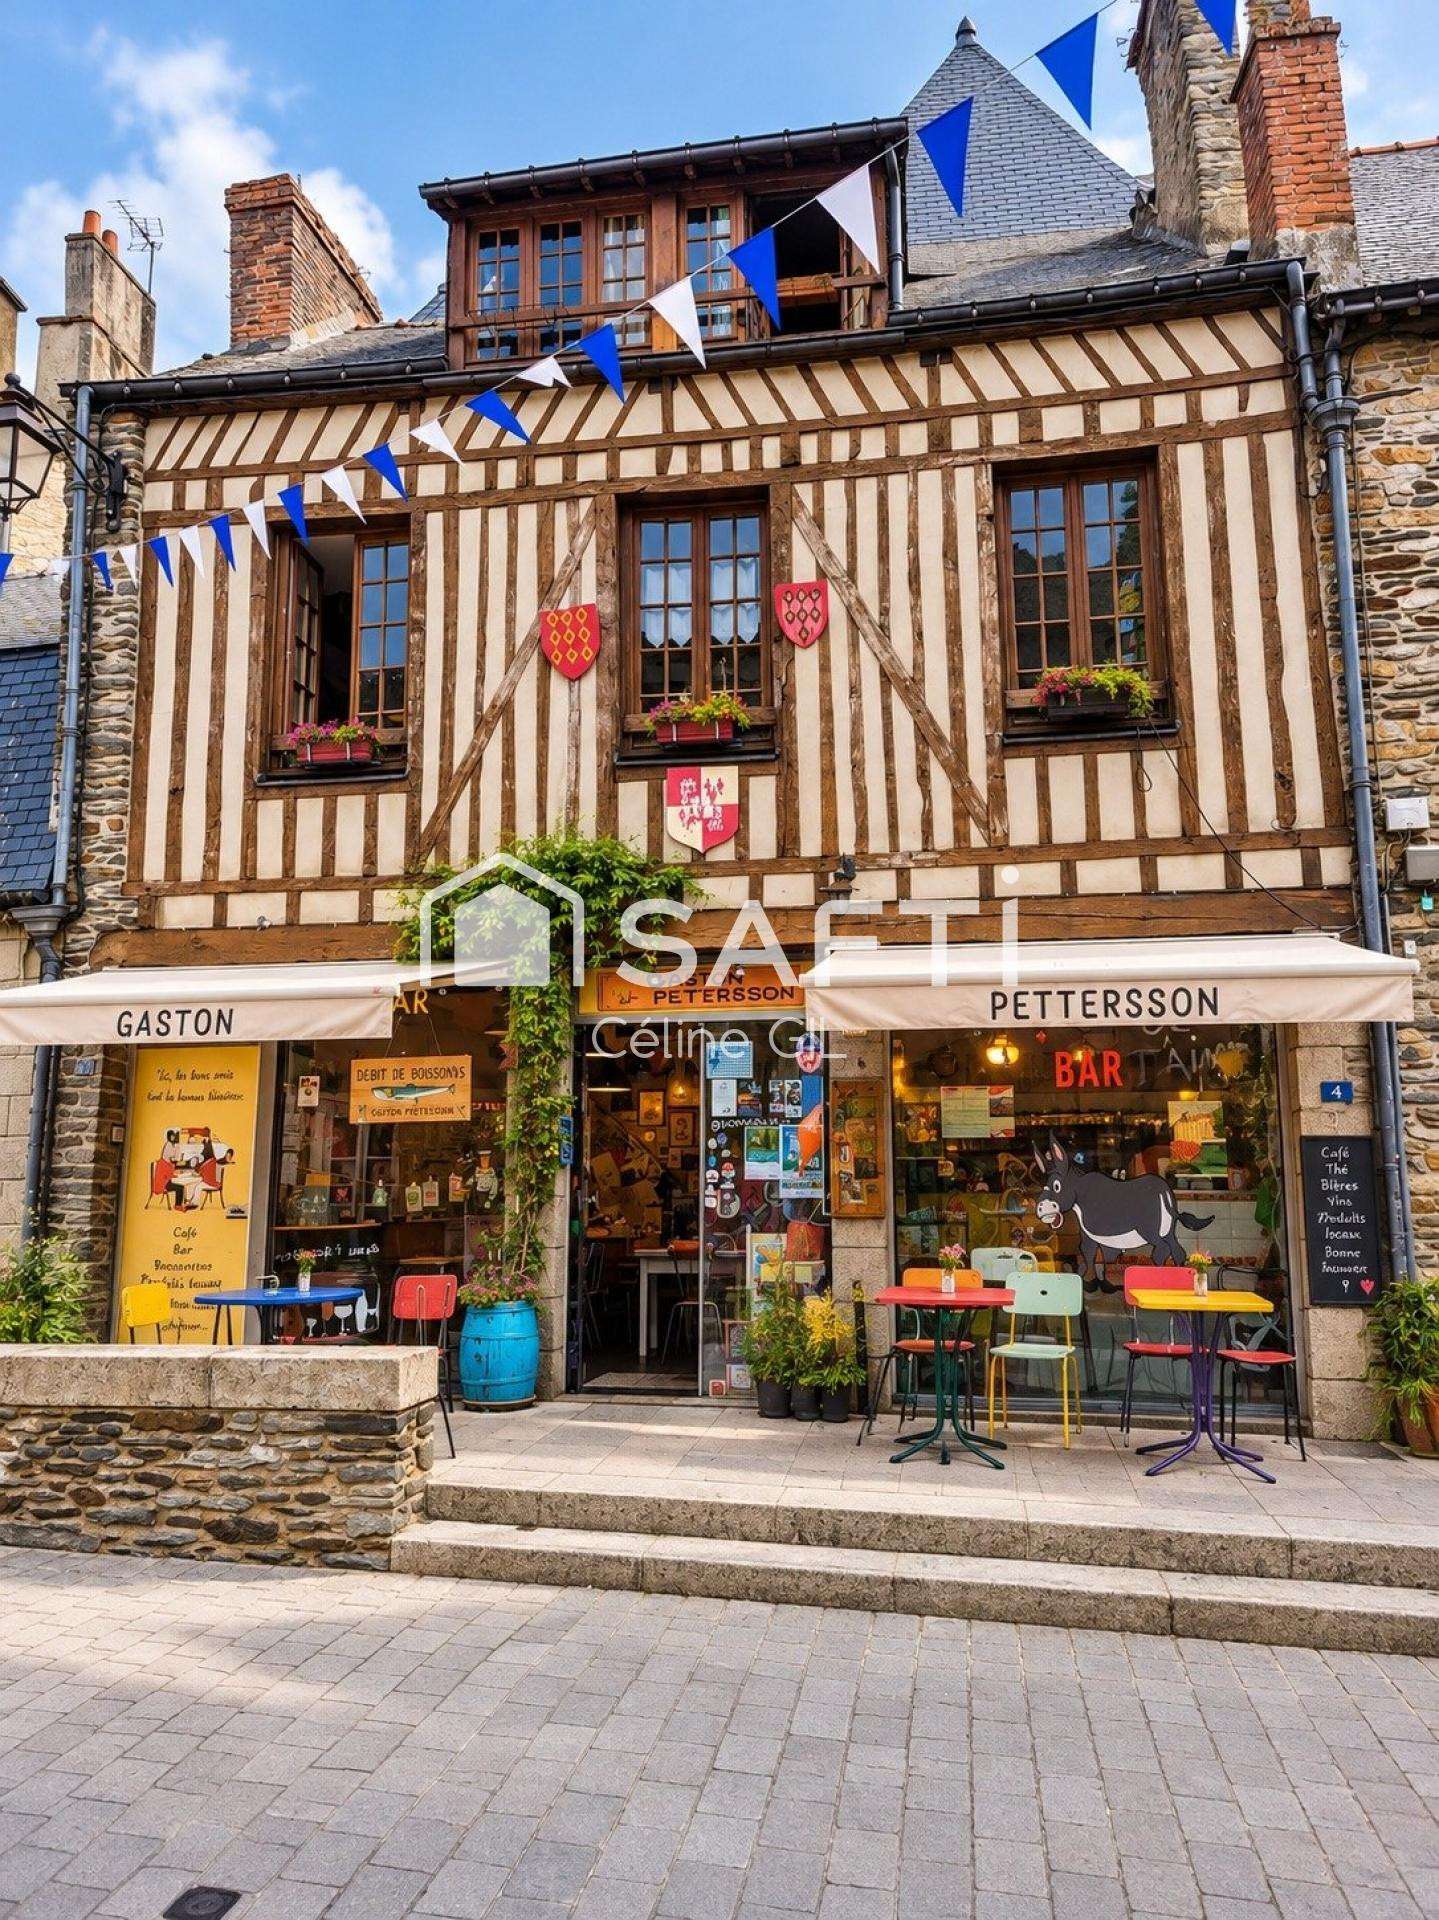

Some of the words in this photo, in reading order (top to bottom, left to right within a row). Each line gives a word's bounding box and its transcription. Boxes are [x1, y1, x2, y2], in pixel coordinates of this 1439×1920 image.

[393, 989, 429, 1014] AR
[653, 986, 795, 1004] PETERSSON
[991, 987, 1218, 1020] PETTERSSON
[117, 1008, 233, 1037] GASTON
[1055, 1051, 1123, 1088] BAR
[1331, 1085, 1342, 1099] 4
[1321, 1146, 1350, 1162] Café
[1325, 1162, 1348, 1175] Thé
[173, 1243, 194, 1256] Bar
